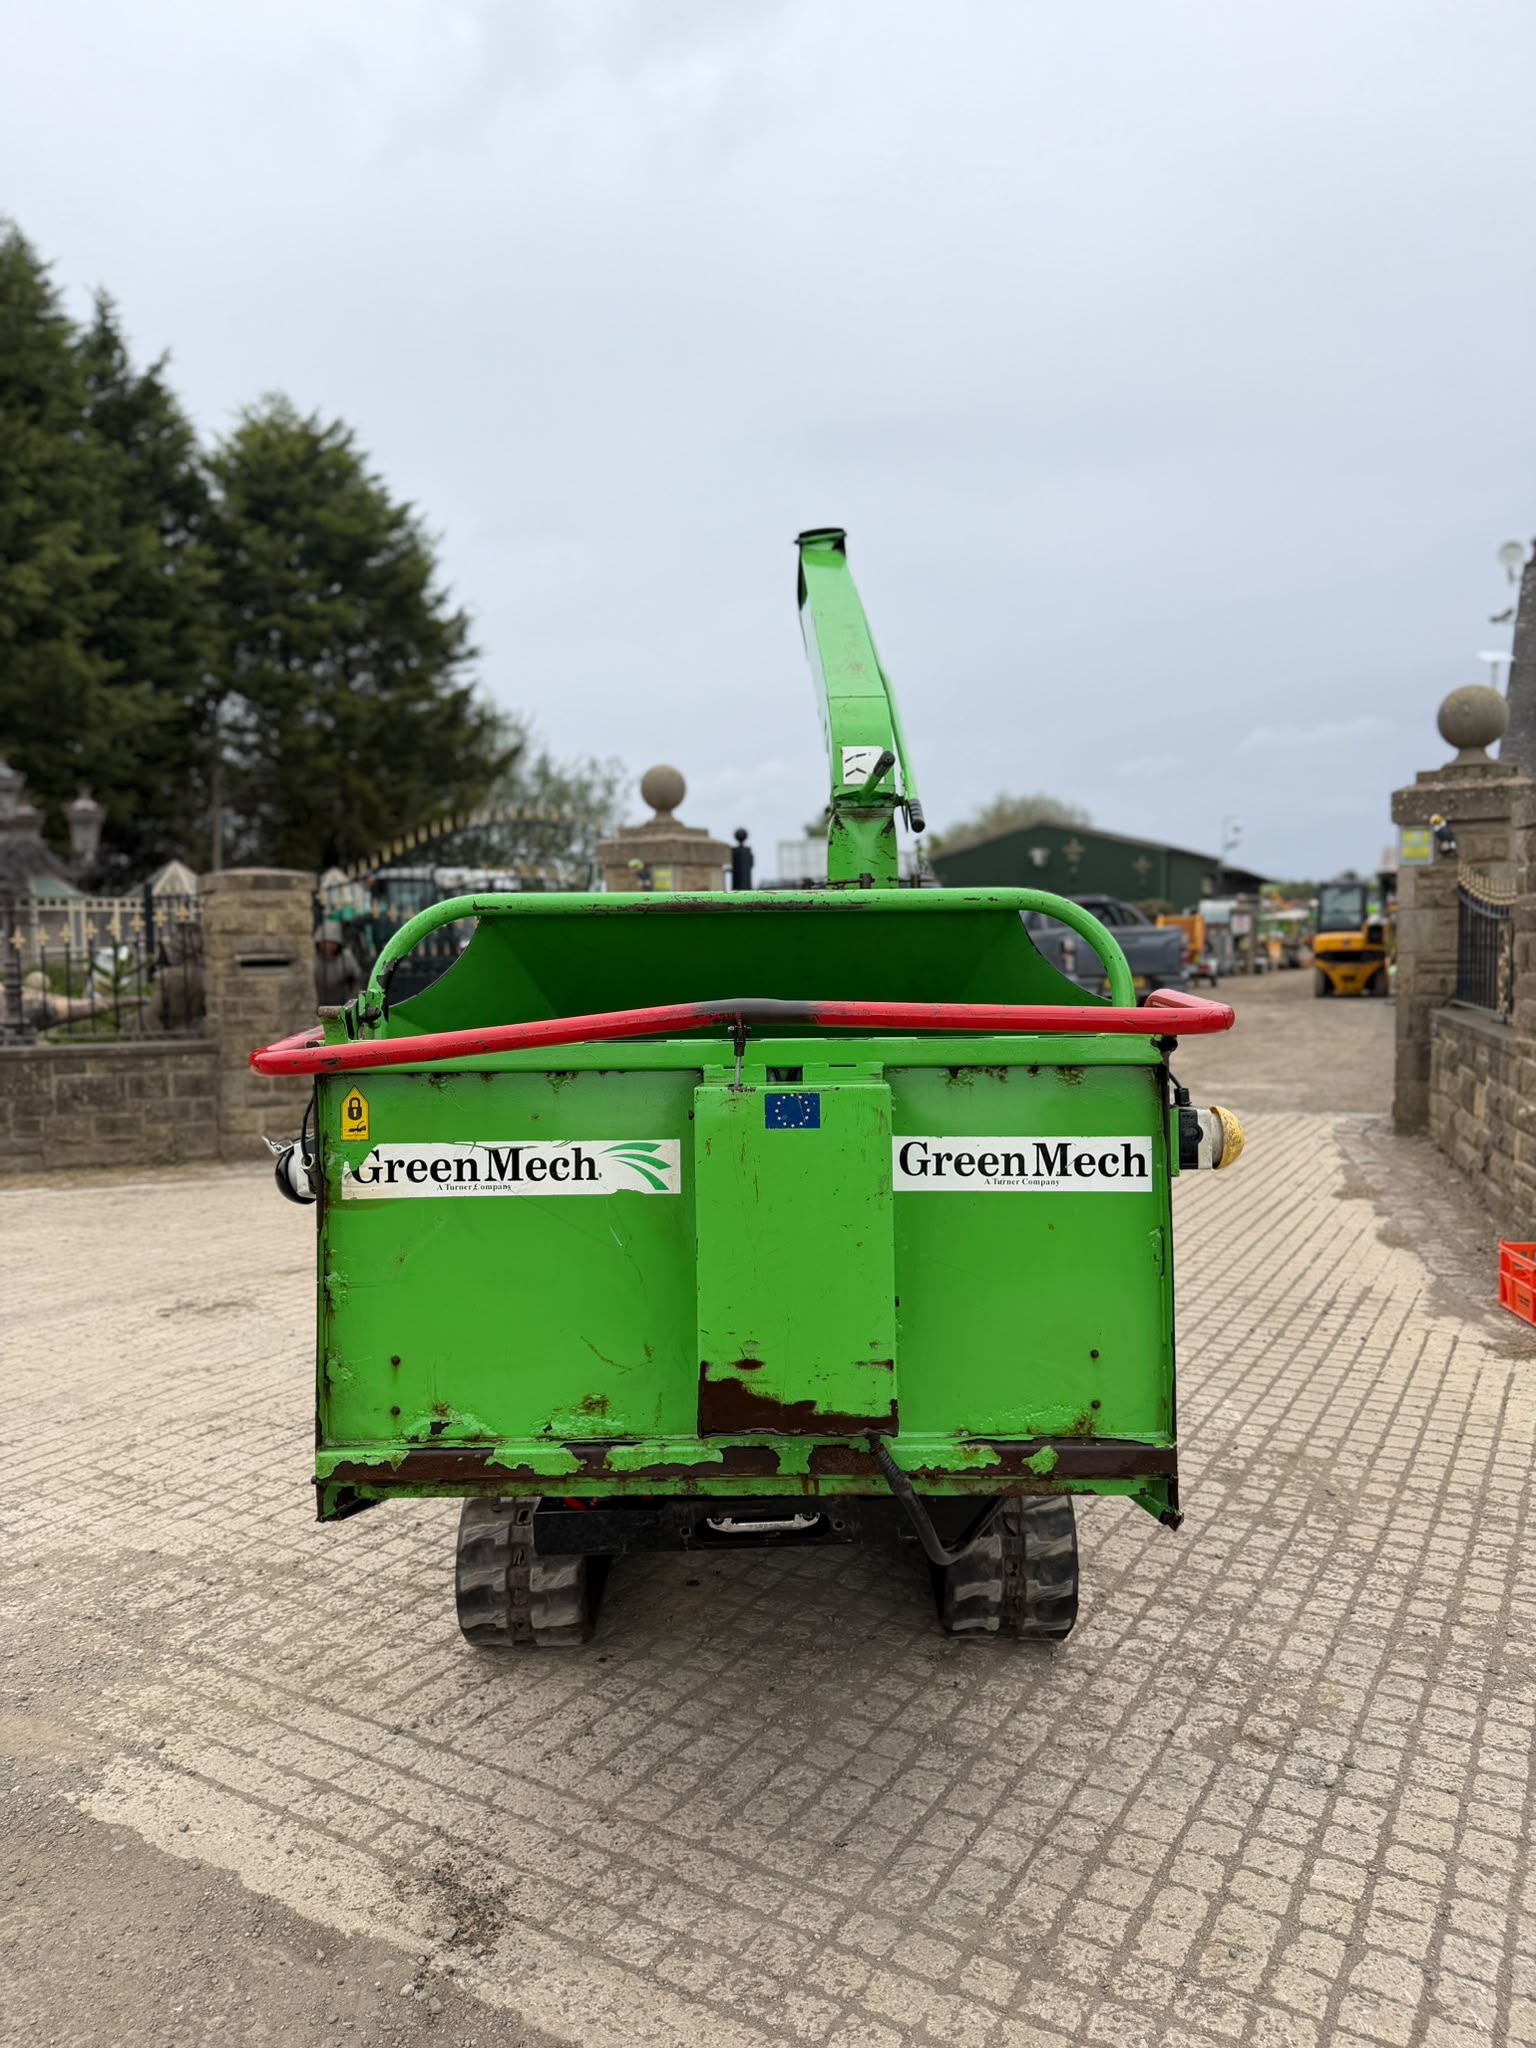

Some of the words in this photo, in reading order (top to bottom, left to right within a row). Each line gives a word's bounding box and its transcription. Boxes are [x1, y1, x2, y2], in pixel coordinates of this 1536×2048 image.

[899, 1141, 1149, 1178] GreenMech
[445, 1183, 472, 1191] Turner
[992, 1177, 1020, 1185] Turner
[1021, 1177, 1060, 1187] Company
